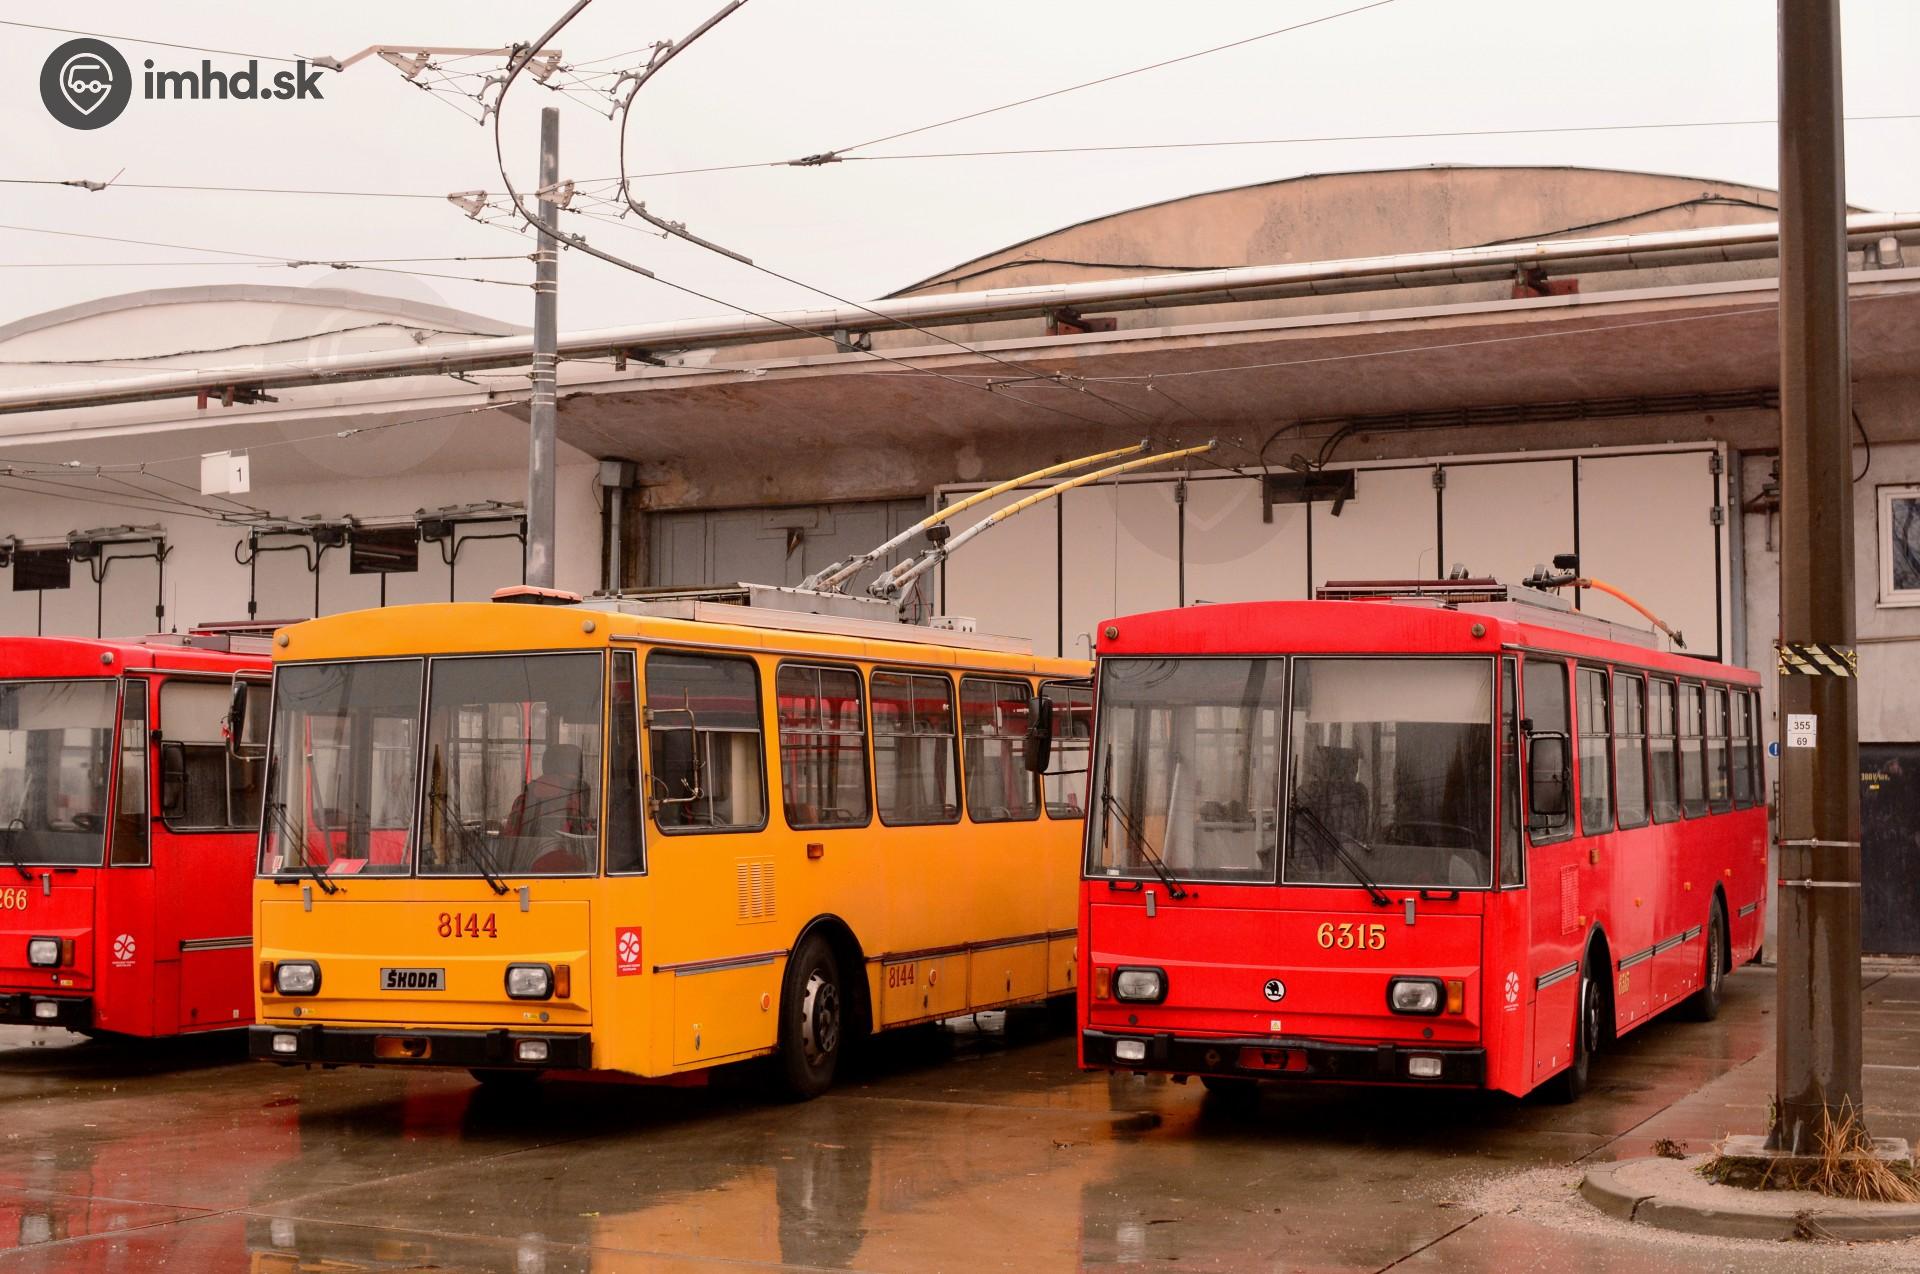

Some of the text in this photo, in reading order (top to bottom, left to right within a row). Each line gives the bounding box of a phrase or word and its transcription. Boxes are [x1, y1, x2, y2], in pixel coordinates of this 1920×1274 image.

[236, 466, 242, 482] 1
[1794, 721, 1811, 730] 355
[1796, 737, 1808, 746] 69
[437, 912, 498, 938] 8144
[1317, 922, 1386, 950] 6315
[386, 969, 438, 988] ŠKODA
[889, 963, 914, 989] 8144
